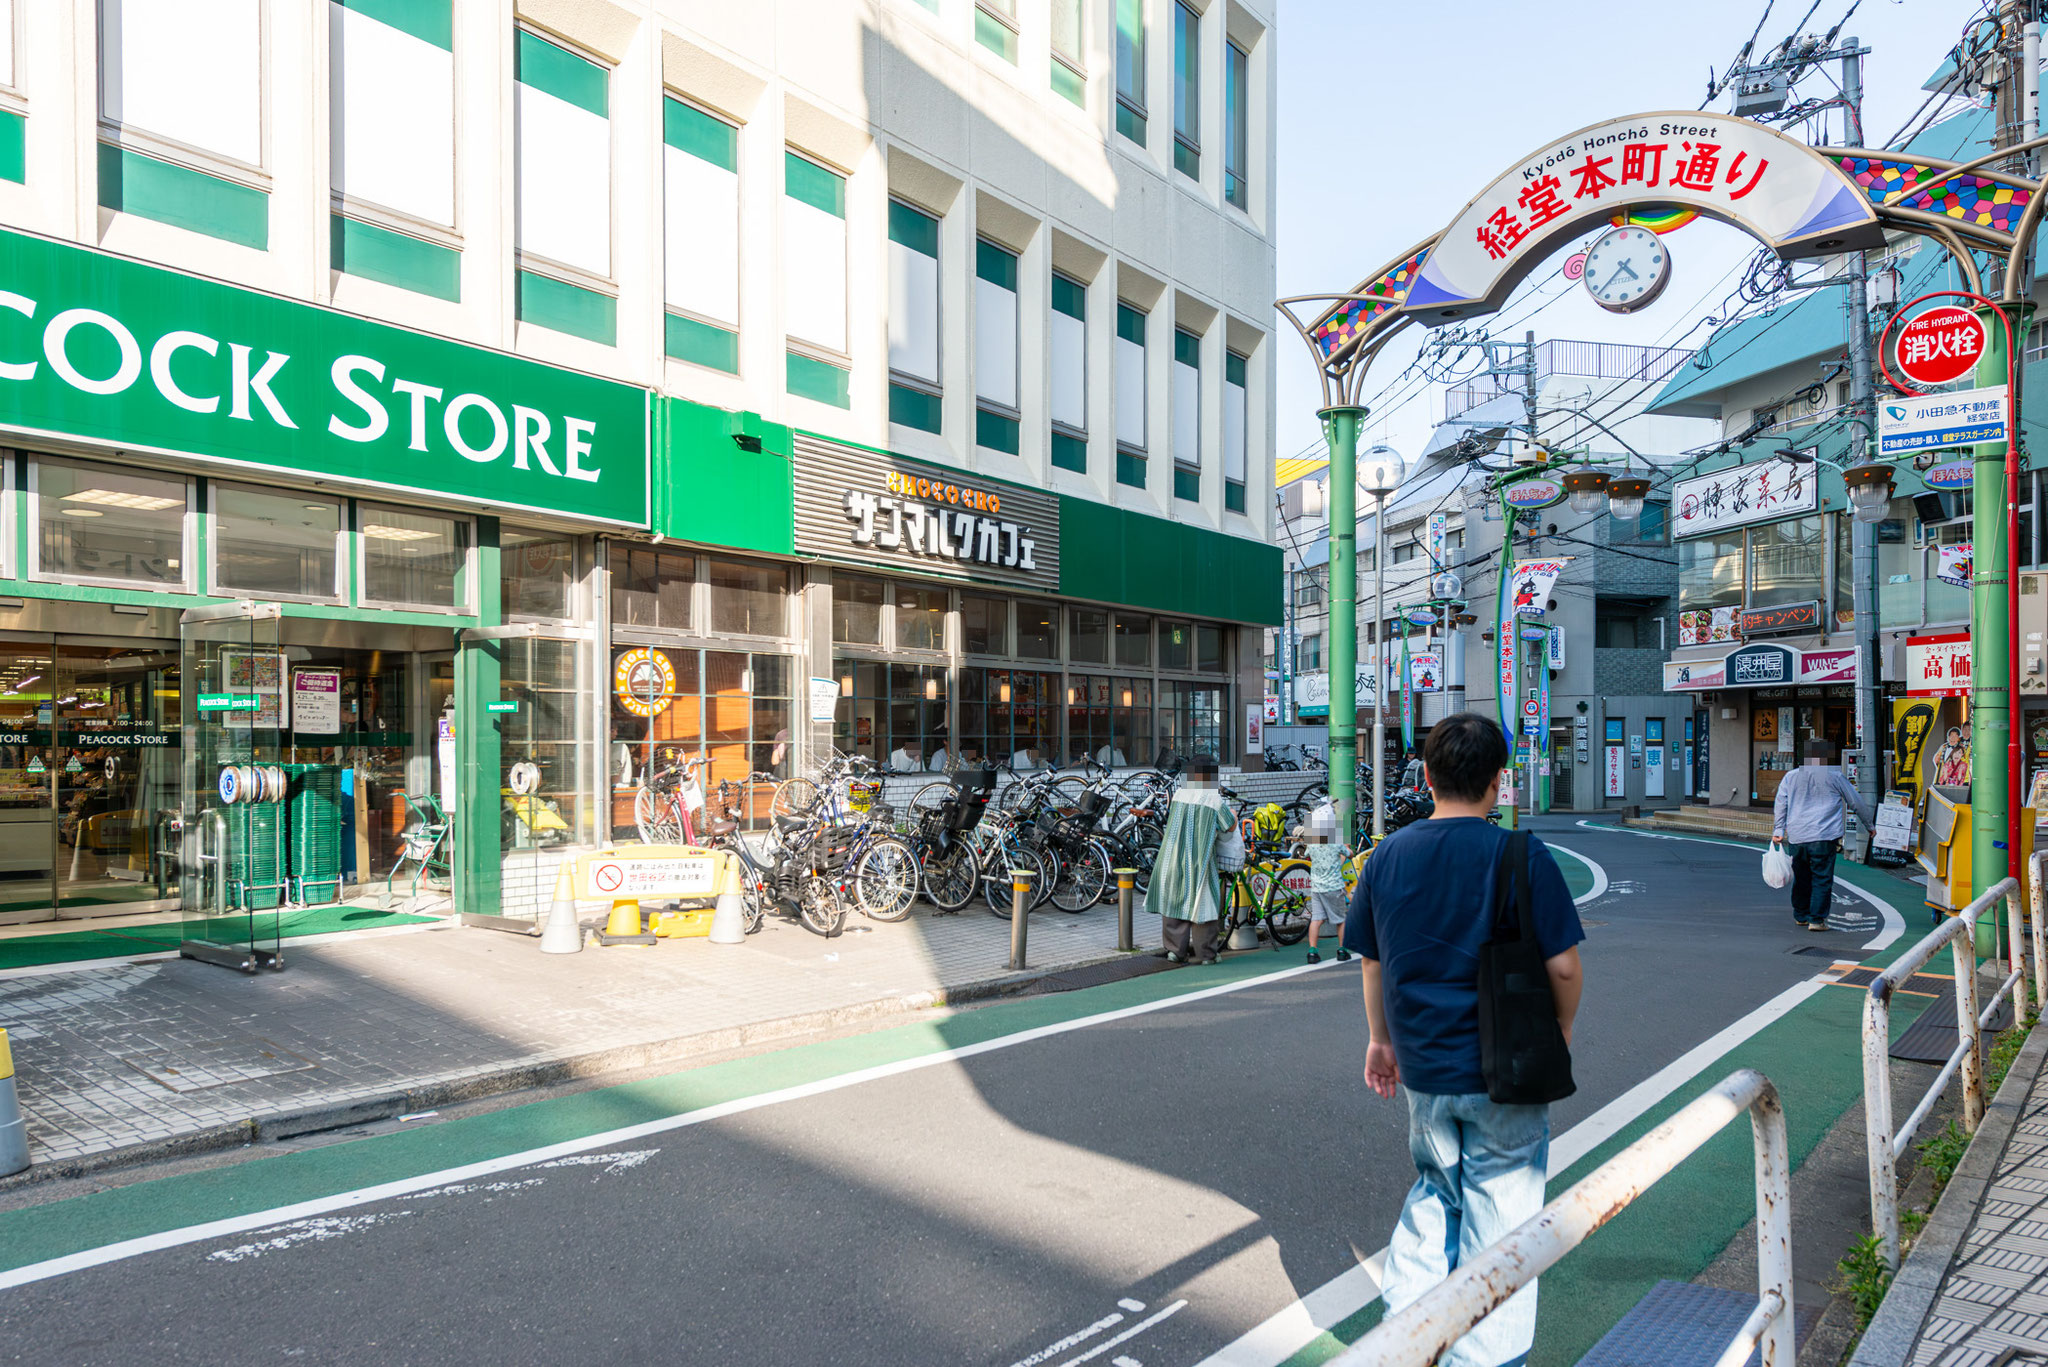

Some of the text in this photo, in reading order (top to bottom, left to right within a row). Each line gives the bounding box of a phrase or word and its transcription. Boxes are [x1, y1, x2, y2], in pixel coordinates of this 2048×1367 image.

[1522, 123, 1718, 181] Kyōdō Honchō Street
[1476, 141, 1770, 261] 経堂本町通り
[1911, 313, 1970, 331] FIRE HYDRANT
[1904, 325, 1979, 365] 消火栓
[1916, 399, 2001, 419] 小田急不動産
[1966, 411, 2001, 423] 経堂店
[328, 354, 601, 484] STORE
[1883, 428, 2002, 449] 不動産の売却・購入 経堂テラスガーデン内
[886, 470, 1000, 514] CHOCO CRO
[1509, 486, 1555, 502] ほんちょう
[843, 490, 1036, 570] サンマルクカフェ
[1501, 621, 1513, 697] 経堂本町通り
[1807, 658, 1839, 671] WINE
[1923, 653, 1971, 680] 高価
[1677, 666, 1690, 684] 酒
[1737, 669, 1782, 680] ENSHUYA
[1774, 689, 1788, 697] GIFT
[1798, 687, 1822, 696] ENSHUYA
[1832, 686, 1854, 695] LIQUO
[79, 735, 169, 744] PEACOCK STORE
[1646, 749, 1661, 766] 恵
[1610, 747, 1618, 795] 処方せん受付
